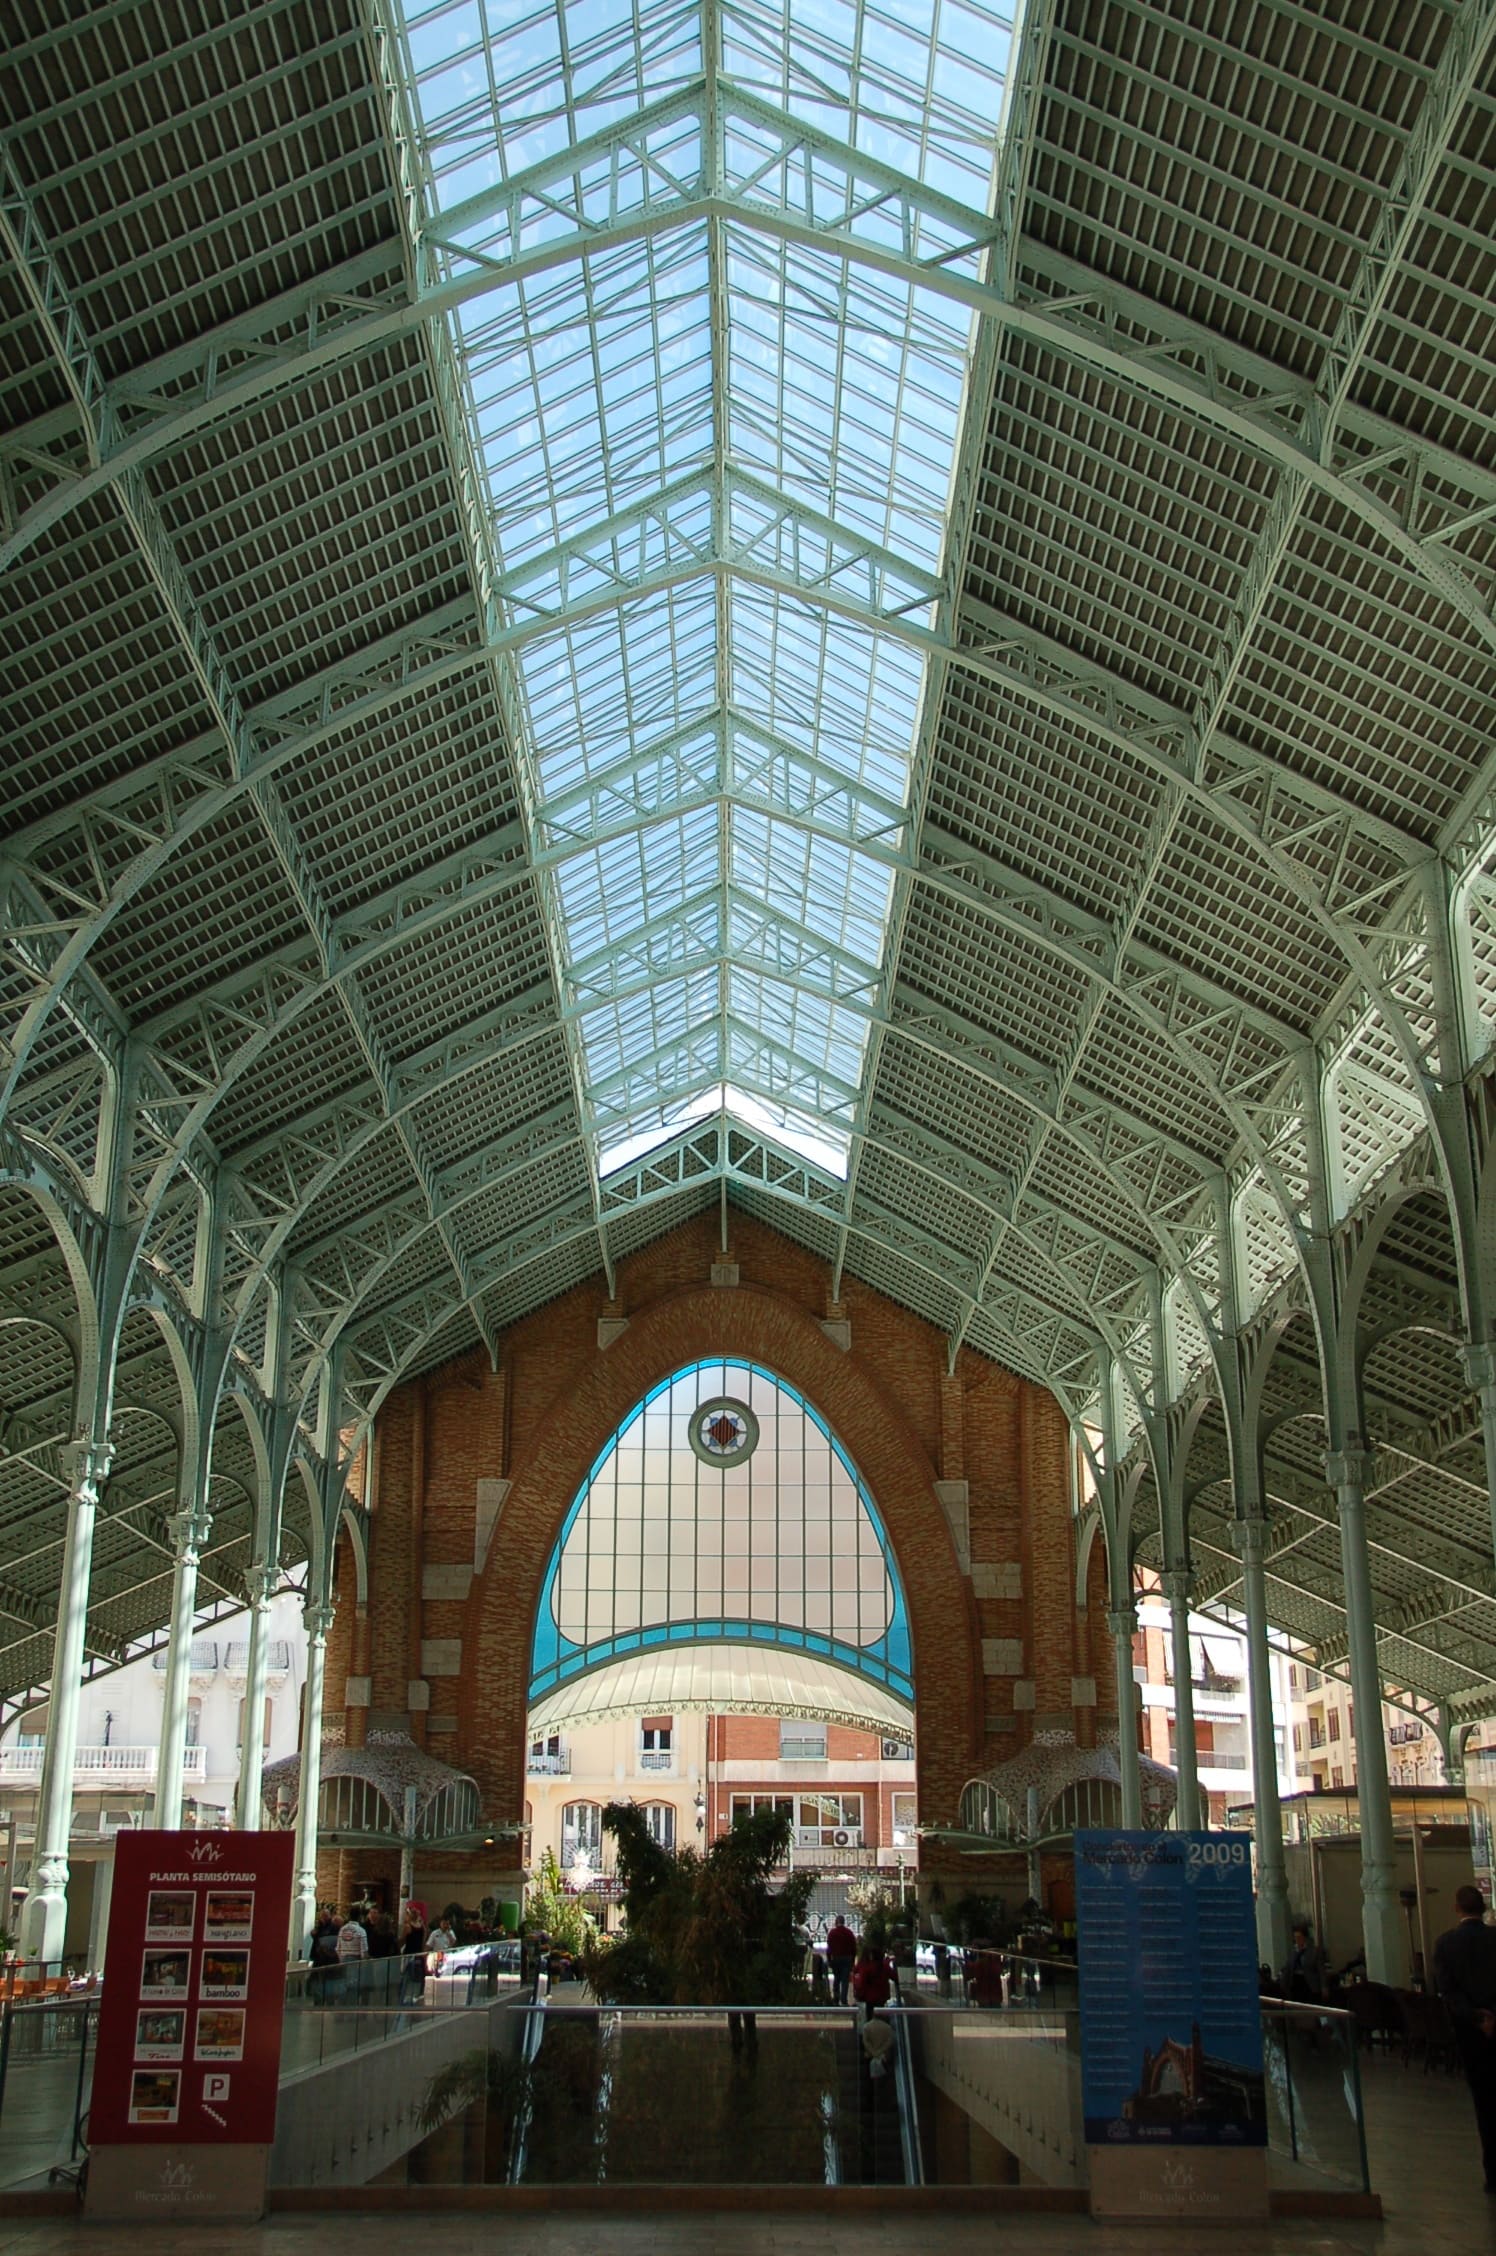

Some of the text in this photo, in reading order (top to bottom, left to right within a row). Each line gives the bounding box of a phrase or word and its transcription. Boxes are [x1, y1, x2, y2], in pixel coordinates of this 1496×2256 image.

[1083, 1852, 1141, 1865] Mercado
[1190, 1843, 1245, 1863] 2009
[150, 1870, 257, 1882] PLANTA SEMISÓTANO
[206, 1985, 241, 1998] bamboo
[210, 2079, 225, 2098] P
